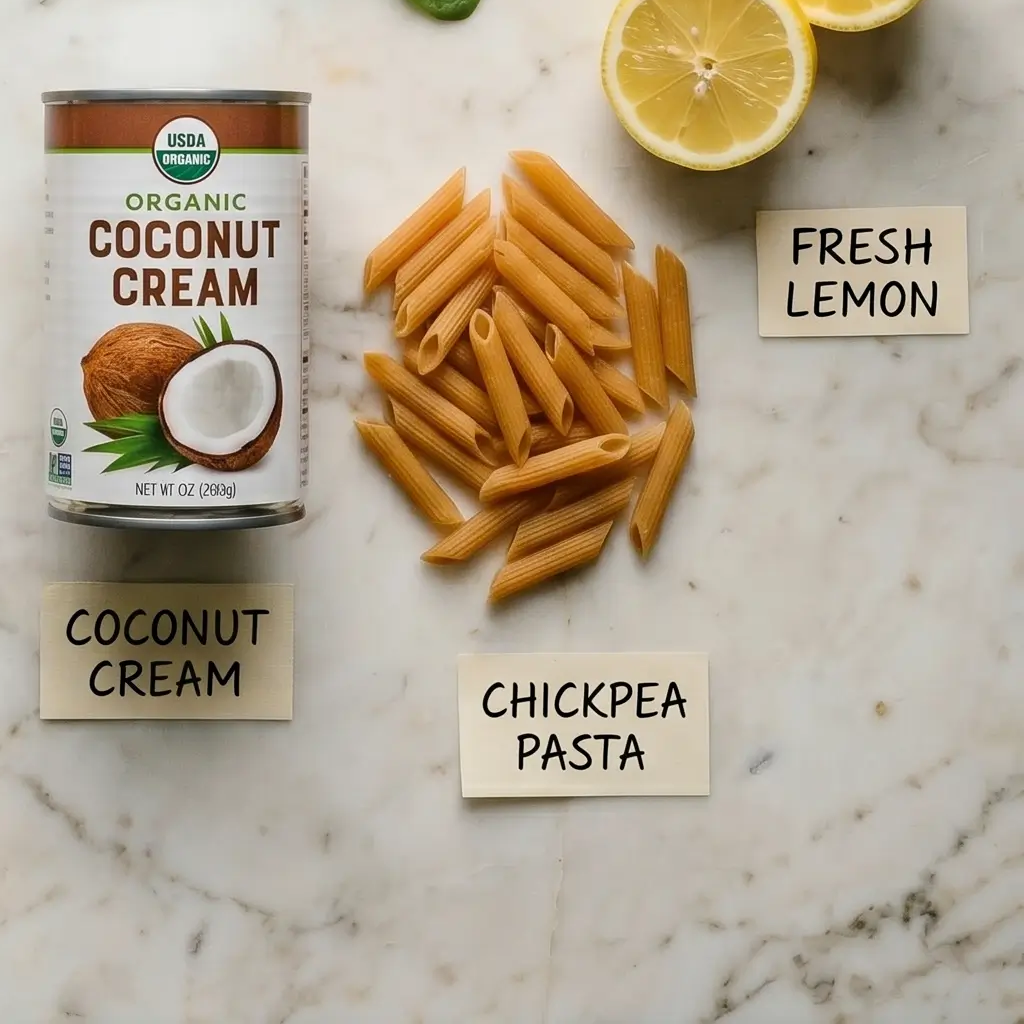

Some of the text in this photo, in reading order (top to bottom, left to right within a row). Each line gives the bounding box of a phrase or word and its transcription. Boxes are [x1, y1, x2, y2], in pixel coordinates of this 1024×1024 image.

[162, 153, 211, 166] ORGANIC
[167, 133, 206, 148] USDA
[126, 193, 247, 212] ORGANIC
[88, 219, 280, 259] COCONUT
[792, 227, 933, 266] FRESH
[112, 266, 258, 307] CREAM
[786, 280, 938, 318] LEMON
[135, 482, 157, 496] NET
[160, 483, 175, 496] WT
[178, 483, 195, 496] OZ
[65, 607, 270, 646] COCONUT
[89, 659, 241, 697] CREAM
[482, 681, 687, 719] CHICKPEA
[517, 733, 645, 771] PASTA
